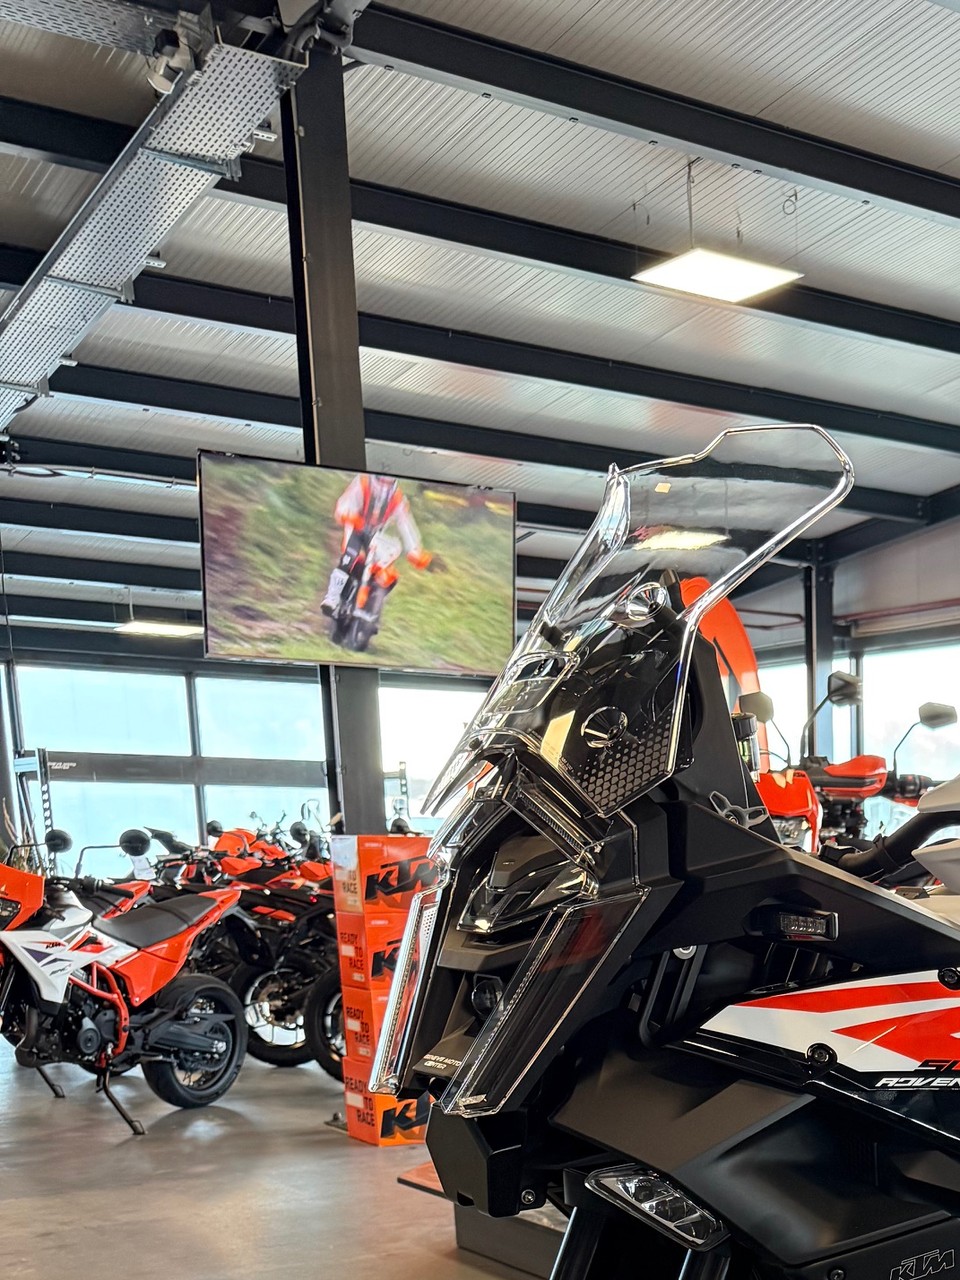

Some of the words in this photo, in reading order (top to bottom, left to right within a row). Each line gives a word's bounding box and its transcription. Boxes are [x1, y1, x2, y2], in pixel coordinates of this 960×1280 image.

[354, 946, 363, 958] TO
[349, 958, 364, 971] RACE
[346, 1006, 364, 1020] READY
[360, 1021, 370, 1033] TO
[354, 1033, 370, 1046] RACE
[345, 1077, 368, 1093] READY
[363, 1097, 374, 1111] TO
[356, 1109, 375, 1127] RACE
